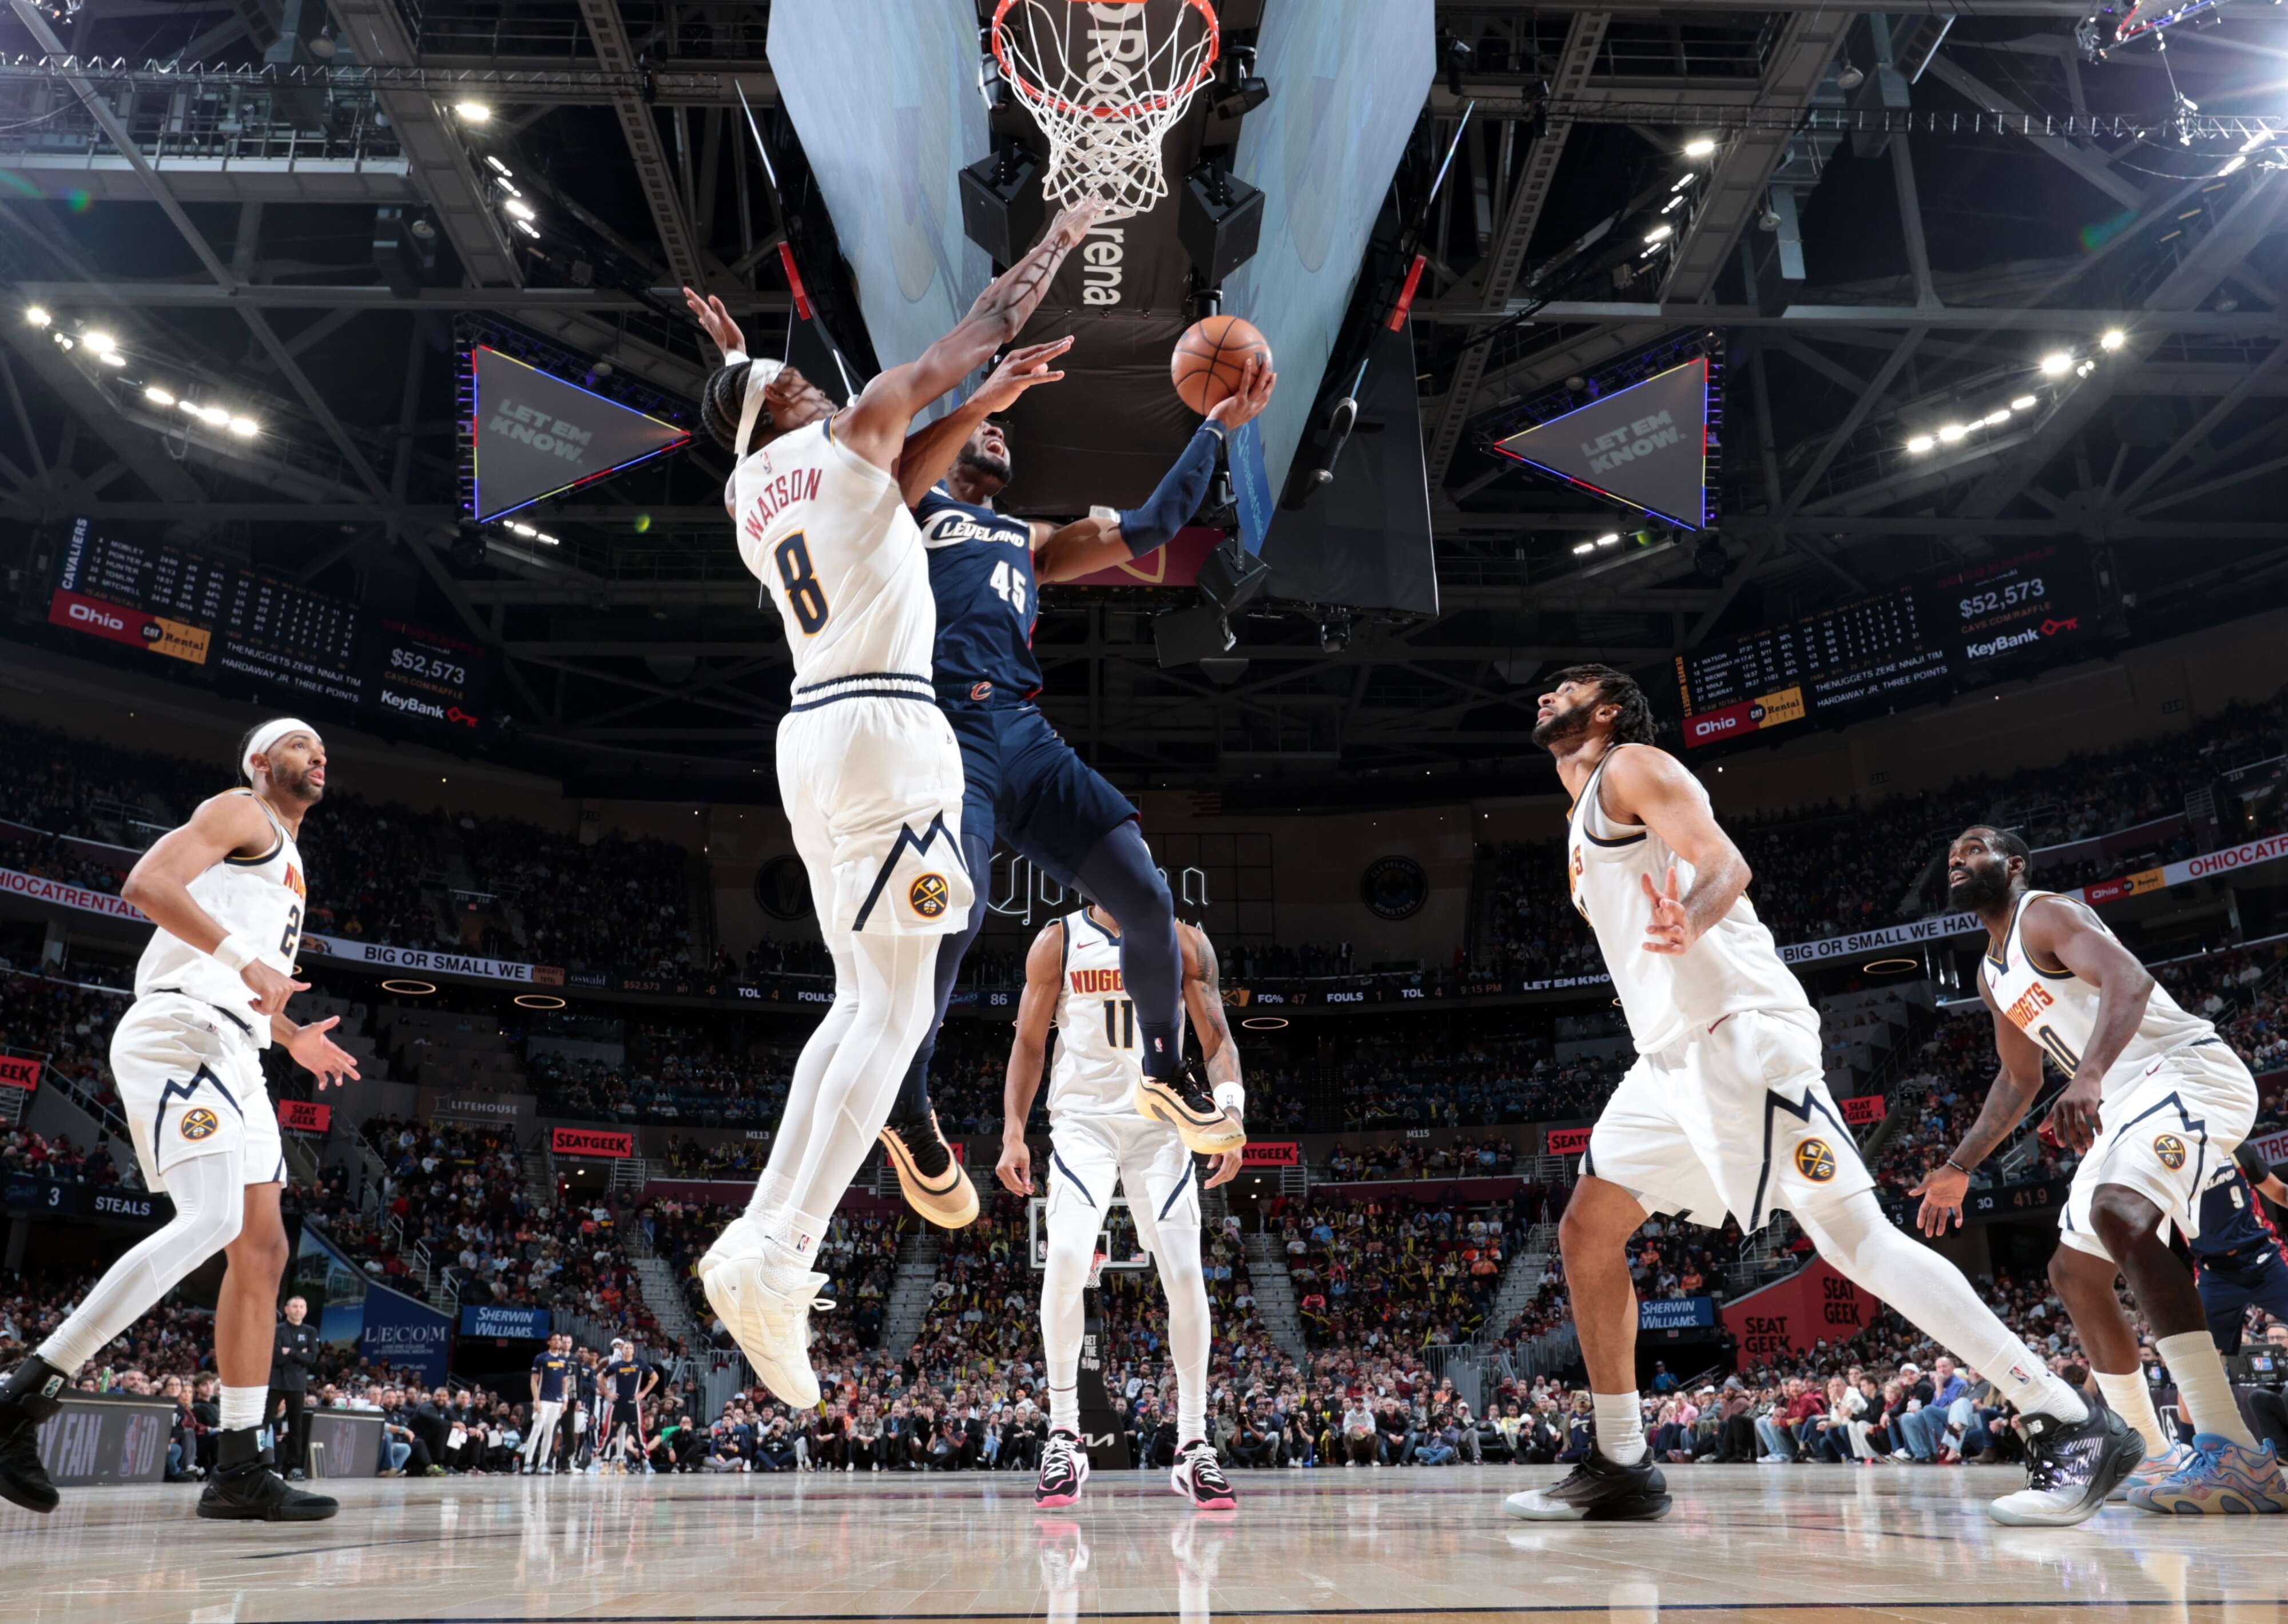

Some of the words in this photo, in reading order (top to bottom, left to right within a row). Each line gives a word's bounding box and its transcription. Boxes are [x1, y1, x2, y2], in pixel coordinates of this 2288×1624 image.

[1083, 203, 1137, 305] Arena
[498, 398, 552, 428] LET
[551, 419, 591, 446] EM
[489, 415, 583, 464] KNOW.
[1581, 426, 1628, 458] LET
[1630, 410, 1673, 436] EM
[1590, 426, 1686, 475] KNOW.
[745, 467, 823, 542] WATSON
[921, 509, 1024, 549] CLEVELAND
[62, 518, 88, 590] CAVALIERS
[108, 550, 141, 565] PORTER
[110, 540, 144, 556] MOBLEY
[105, 569, 136, 583] TOMLIN
[106, 560, 139, 575] HUNTER
[102, 579, 141, 596] MITCHELL
[774, 529, 830, 637] 8
[990, 560, 1026, 614] 45
[1959, 578, 2045, 619] $52,573
[69, 603, 124, 630] Ohio
[143, 626, 160, 638] CAT
[165, 633, 204, 650] Rental
[1966, 628, 2039, 658] KeyBank
[227, 641, 291, 667] THENUGGETS
[292, 661, 315, 674] ZEKE
[317, 668, 344, 682] NNAJI
[345, 675, 362, 687] TIM
[390, 648, 464, 684] $52,573
[1701, 652, 1727, 665] WATSON
[221, 657, 275, 678] HARDAWAY
[293, 678, 323, 693] THREE
[325, 686, 359, 703] POINTS
[1705, 670, 1728, 682] BROWN
[1815, 669, 1873, 693] THENUGGETS
[1875, 663, 1897, 677] ZEKE
[1898, 655, 1924, 669] NNAJI
[1926, 649, 1944, 661] TIM
[1707, 686, 1733, 699] MURRAY
[1817, 688, 1865, 708] HARDAWAY
[1881, 675, 1911, 689] THREE
[1913, 665, 1948, 682] POINTS
[380, 690, 444, 720] KeyBank
[1750, 708, 1763, 720] CAT
[1767, 699, 1800, 714] Rental
[1695, 717, 1737, 736] Ohio
[2092, 887, 2118, 899] Ohio
[1784, 946, 1813, 962] BIG
[1818, 940, 1842, 956] OR
[1848, 929, 1906, 951] SMALL
[1910, 922, 1938, 939] WE
[1943, 914, 1979, 933] HAV
[364, 946, 396, 963] BIG
[402, 951, 428, 967] OR
[434, 955, 494, 976] SMALL
[498, 963, 525, 979] WE
[570, 973, 606, 986] oswald
[1523, 980, 1551, 990] LET
[1554, 978, 1576, 988] EM
[623, 980, 660, 991] $52,573
[738, 987, 761, 998] TOL
[772, 990, 779, 1000] 4
[798, 991, 835, 1003] FOULS
[990, 993, 1007, 1005] 86
[1258, 994, 1284, 1004] FG%
[1292, 994, 1307, 1004] 47
[1327, 992, 1364, 1002] FOULS
[1401, 988, 1424, 999] TOL
[1435, 987, 1443, 998] 4
[1485, 983, 1501, 993] PM
[1103, 999, 1134, 1049] 11
[293, 1105, 317, 1115] SEAT
[451, 1100, 517, 1114] LITEHOUSE
[1849, 1099, 1870, 1110] SEAT
[1849, 1110, 1873, 1120] GEEK
[290, 1115, 316, 1126] GEEK
[557, 1133, 626, 1153] SEATGEEK
[746, 1130, 769, 1139] M113
[1407, 1129, 1429, 1138] M115
[48, 1187, 59, 1206] 3
[95, 1196, 150, 1216] STEALS
[1977, 1197, 1993, 1209] 3Q
[2013, 1188, 2048, 1207] 41.9
[2230, 1185, 2245, 1209] 9
[1896, 1213, 1904, 1225] 5
[1823, 1277, 1855, 1300] SEAT
[477, 1307, 534, 1323] SHERWIN
[1642, 1301, 1695, 1315] SHERWIN
[1824, 1303, 1861, 1327] GEEK
[1745, 1316, 1787, 1334] SEAT
[1084, 1335, 1097, 1345] GET
[1745, 1336, 1792, 1352] GEEK
[1084, 1345, 1097, 1357] THE
[56, 1413, 103, 1476] FAN
